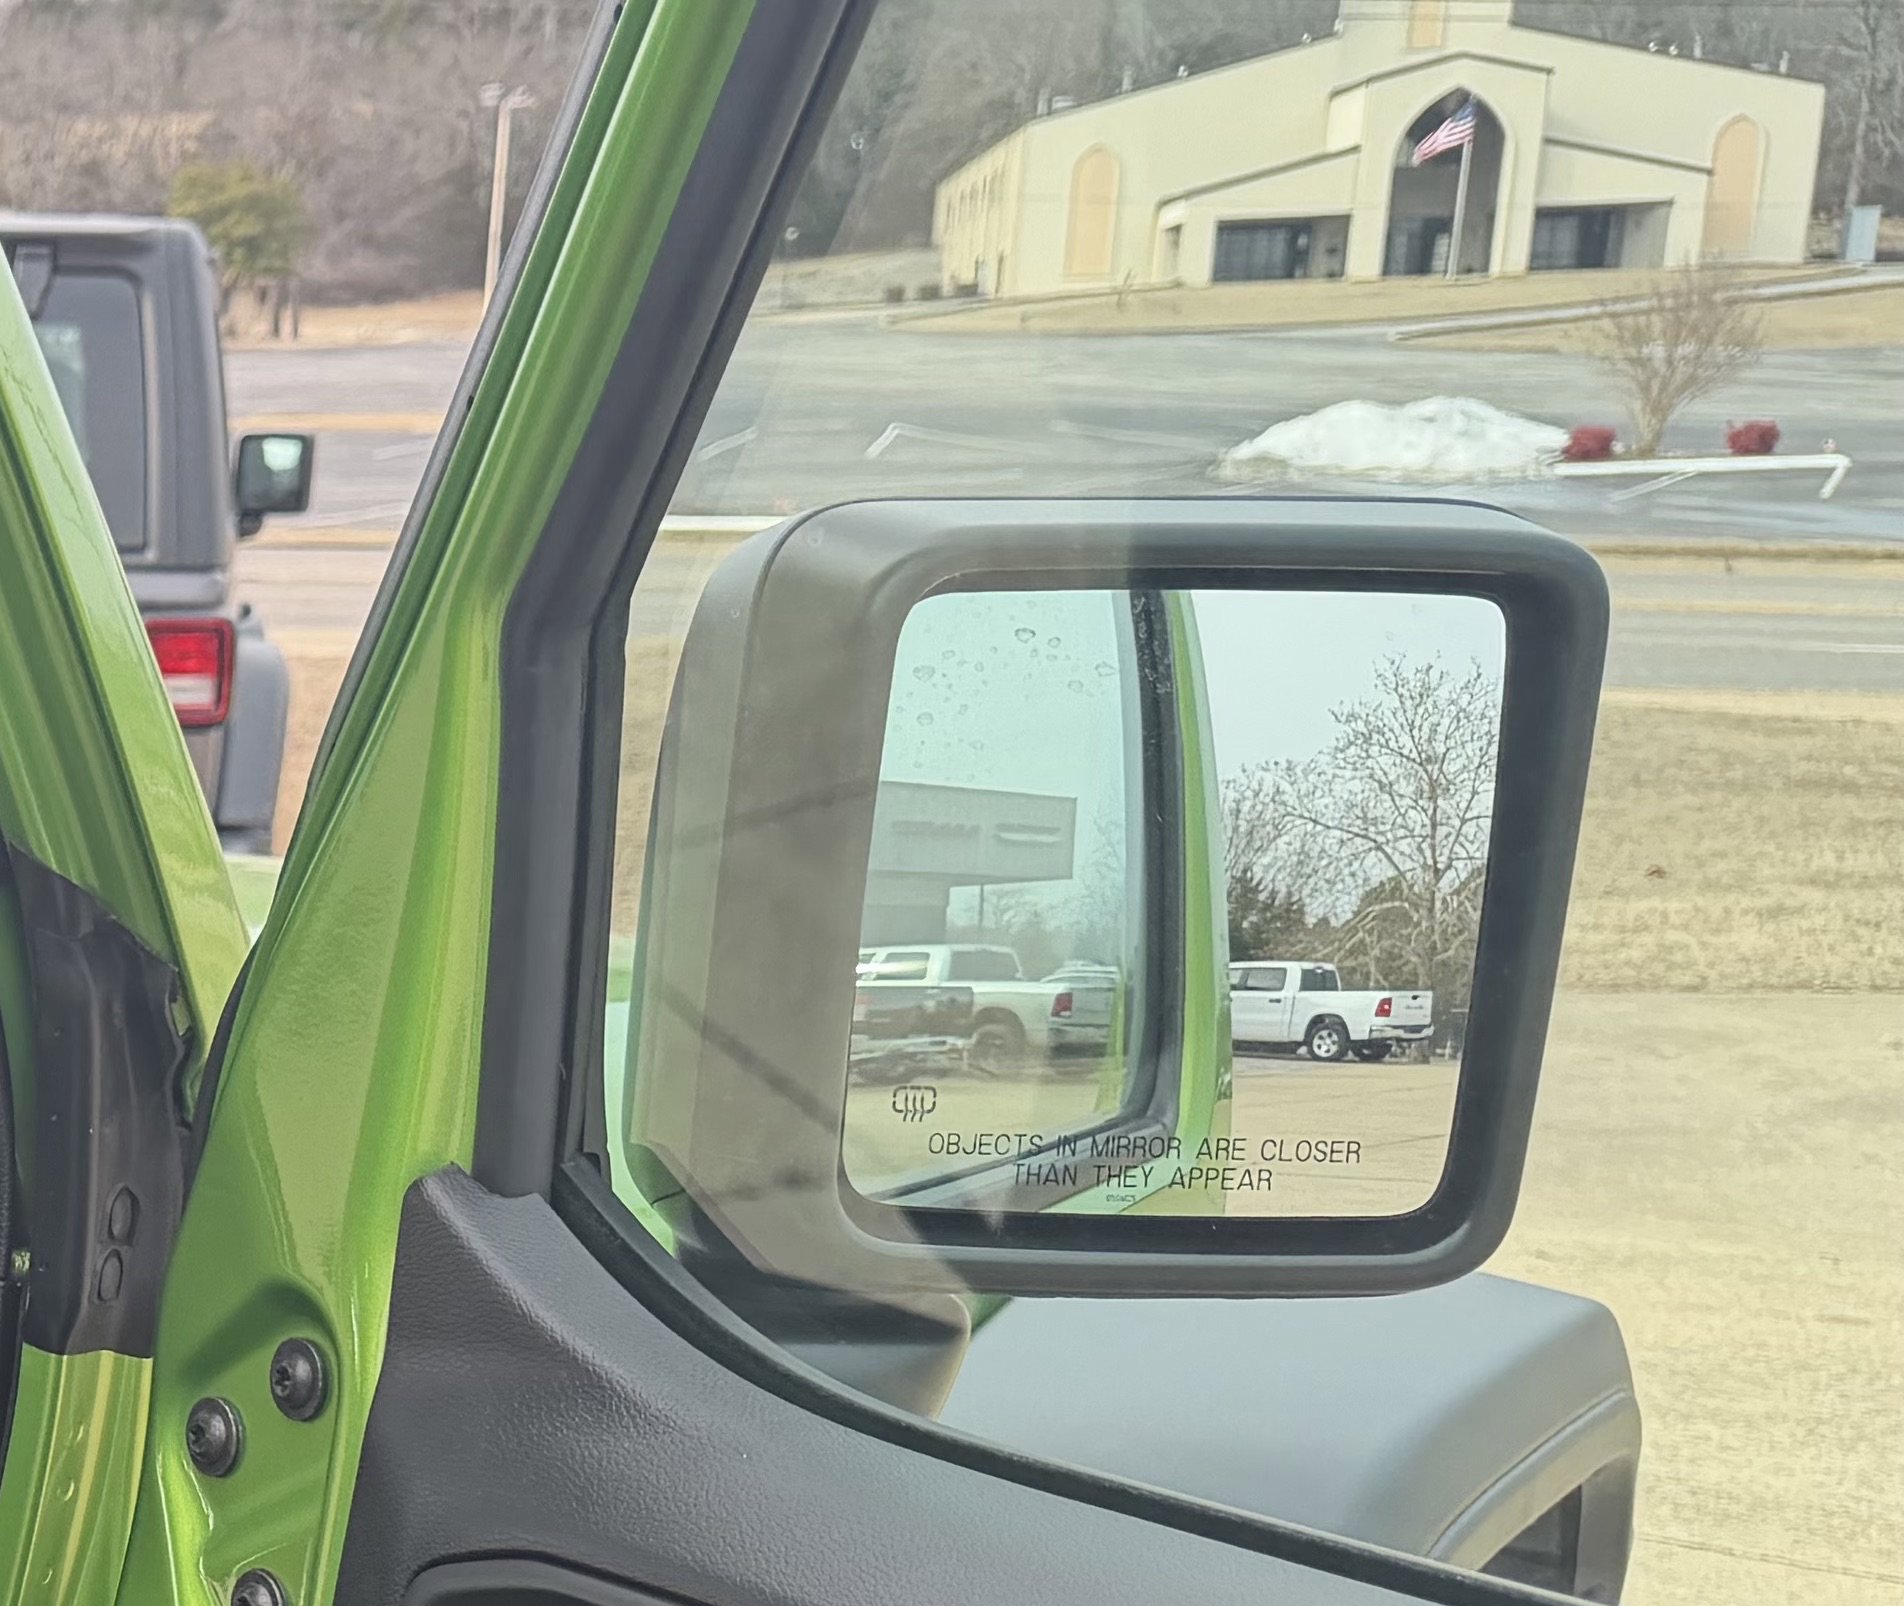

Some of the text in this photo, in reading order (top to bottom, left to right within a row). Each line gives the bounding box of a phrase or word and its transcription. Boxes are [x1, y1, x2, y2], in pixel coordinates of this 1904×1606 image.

[928, 1132, 1362, 1164] OBJECTS IN MIRROR ARE CLOSER
[1012, 1162, 1273, 1192] THAN THEY APPEAR
